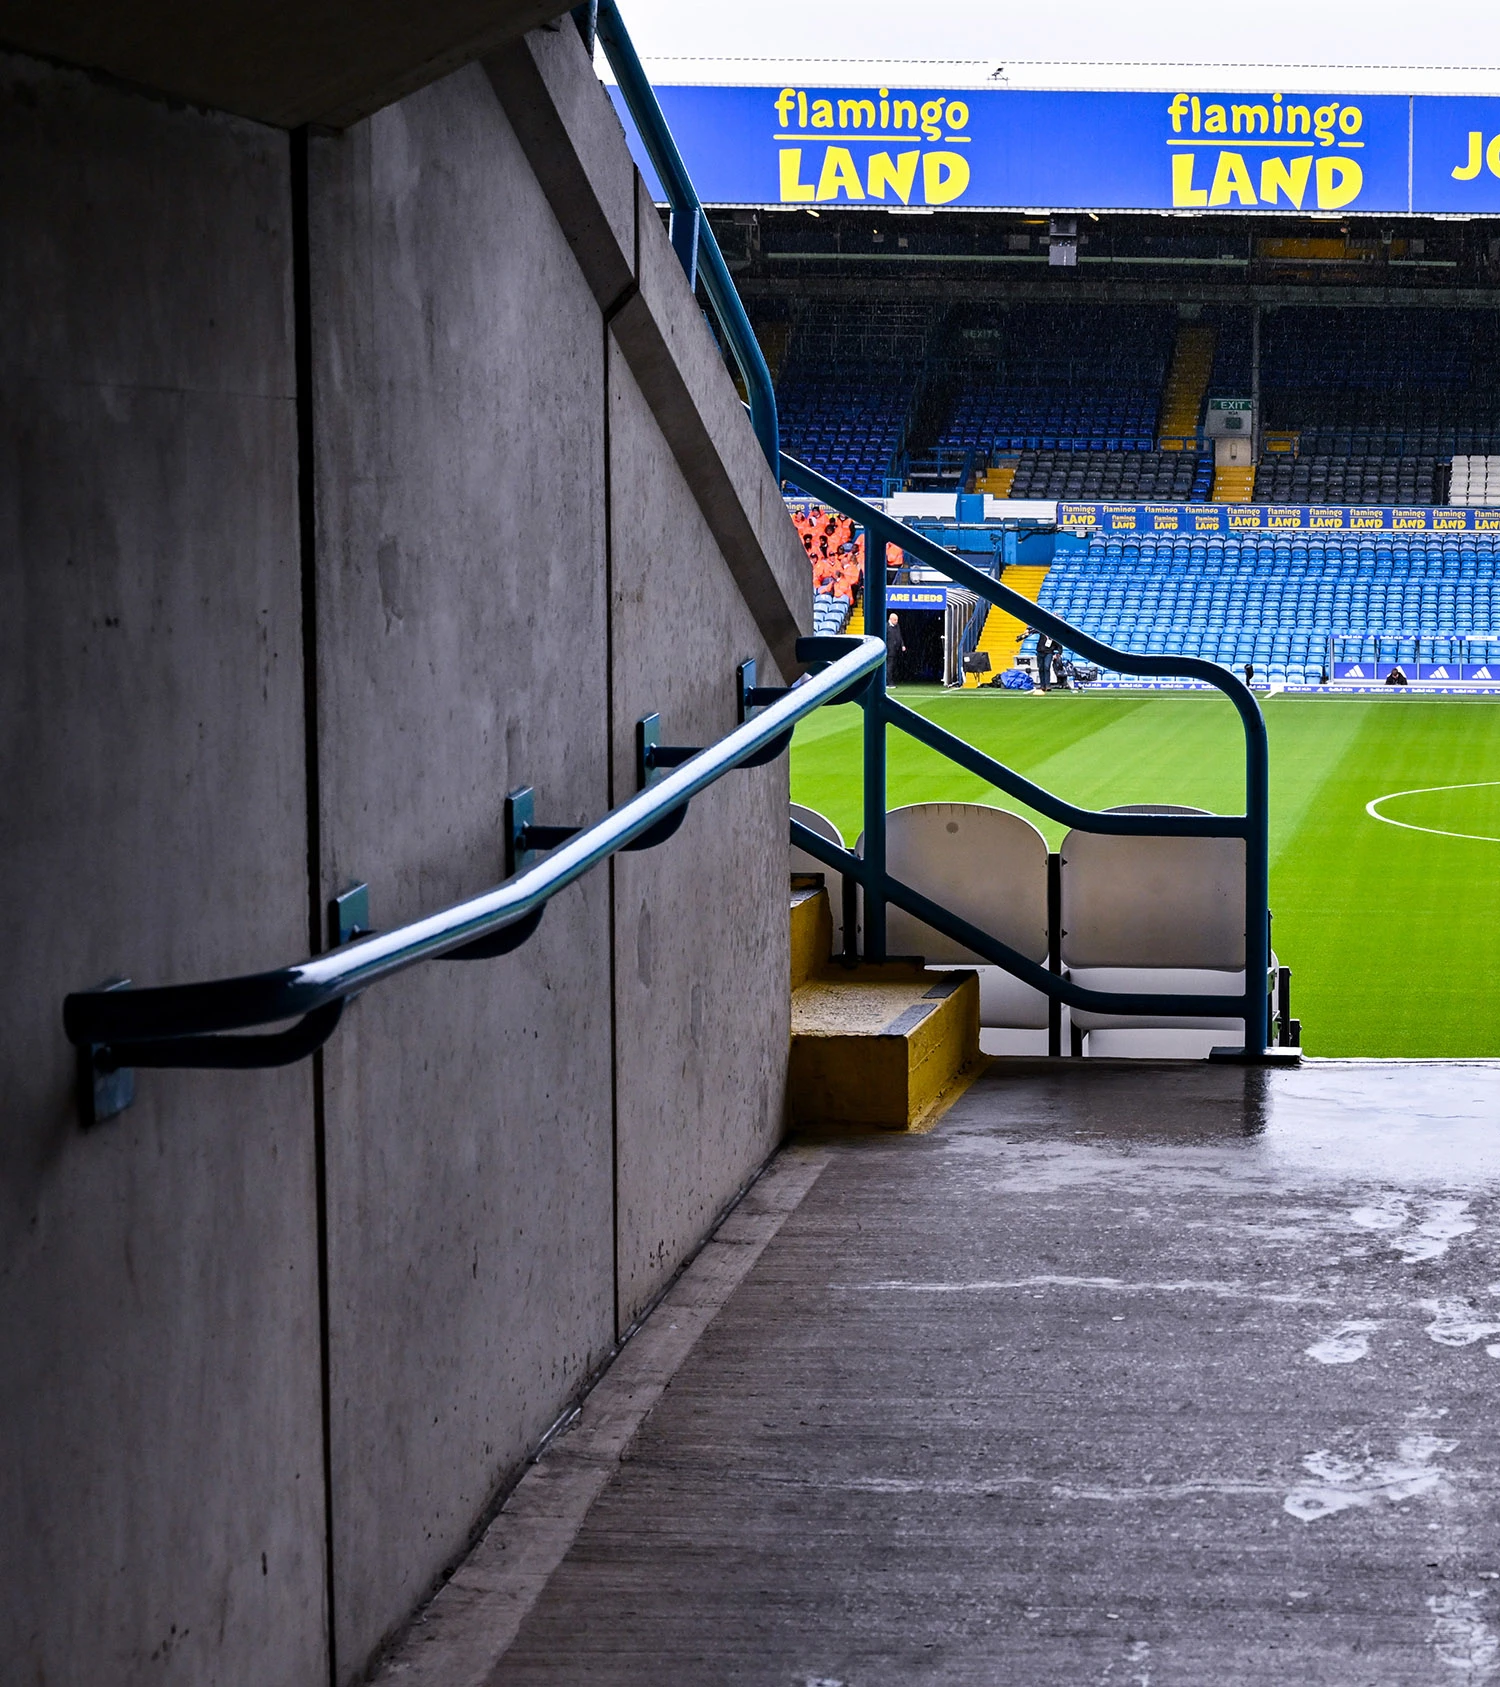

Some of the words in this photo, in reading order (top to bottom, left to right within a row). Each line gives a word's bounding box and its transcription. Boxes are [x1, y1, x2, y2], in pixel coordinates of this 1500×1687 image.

[776, 88, 970, 141] flamingo
[1168, 93, 1363, 146] flamingo
[780, 148, 970, 206] LAND
[1173, 152, 1363, 209] LAND
[1221, 401, 1245, 410] EXIT
[1062, 505, 1095, 514] flamingo
[1227, 507, 1260, 516] flamingo
[1268, 507, 1300, 516] flamingo
[1309, 508, 1342, 516] flamingo
[1350, 508, 1382, 517] flamingo
[1392, 508, 1426, 518] flamingo
[1432, 509, 1466, 518] flamingo
[1062, 515, 1096, 525] LAND
[1229, 517, 1260, 527] LAND
[1268, 518, 1301, 527] LAND
[1310, 518, 1343, 528] LAND
[1350, 518, 1383, 528] LAND
[1392, 519, 1426, 529] LAND
[1433, 519, 1466, 530] LAND
[1154, 522, 1178, 530] LAND
[890, 594, 910, 602] ARE
[912, 594, 943, 602] LEEDS
